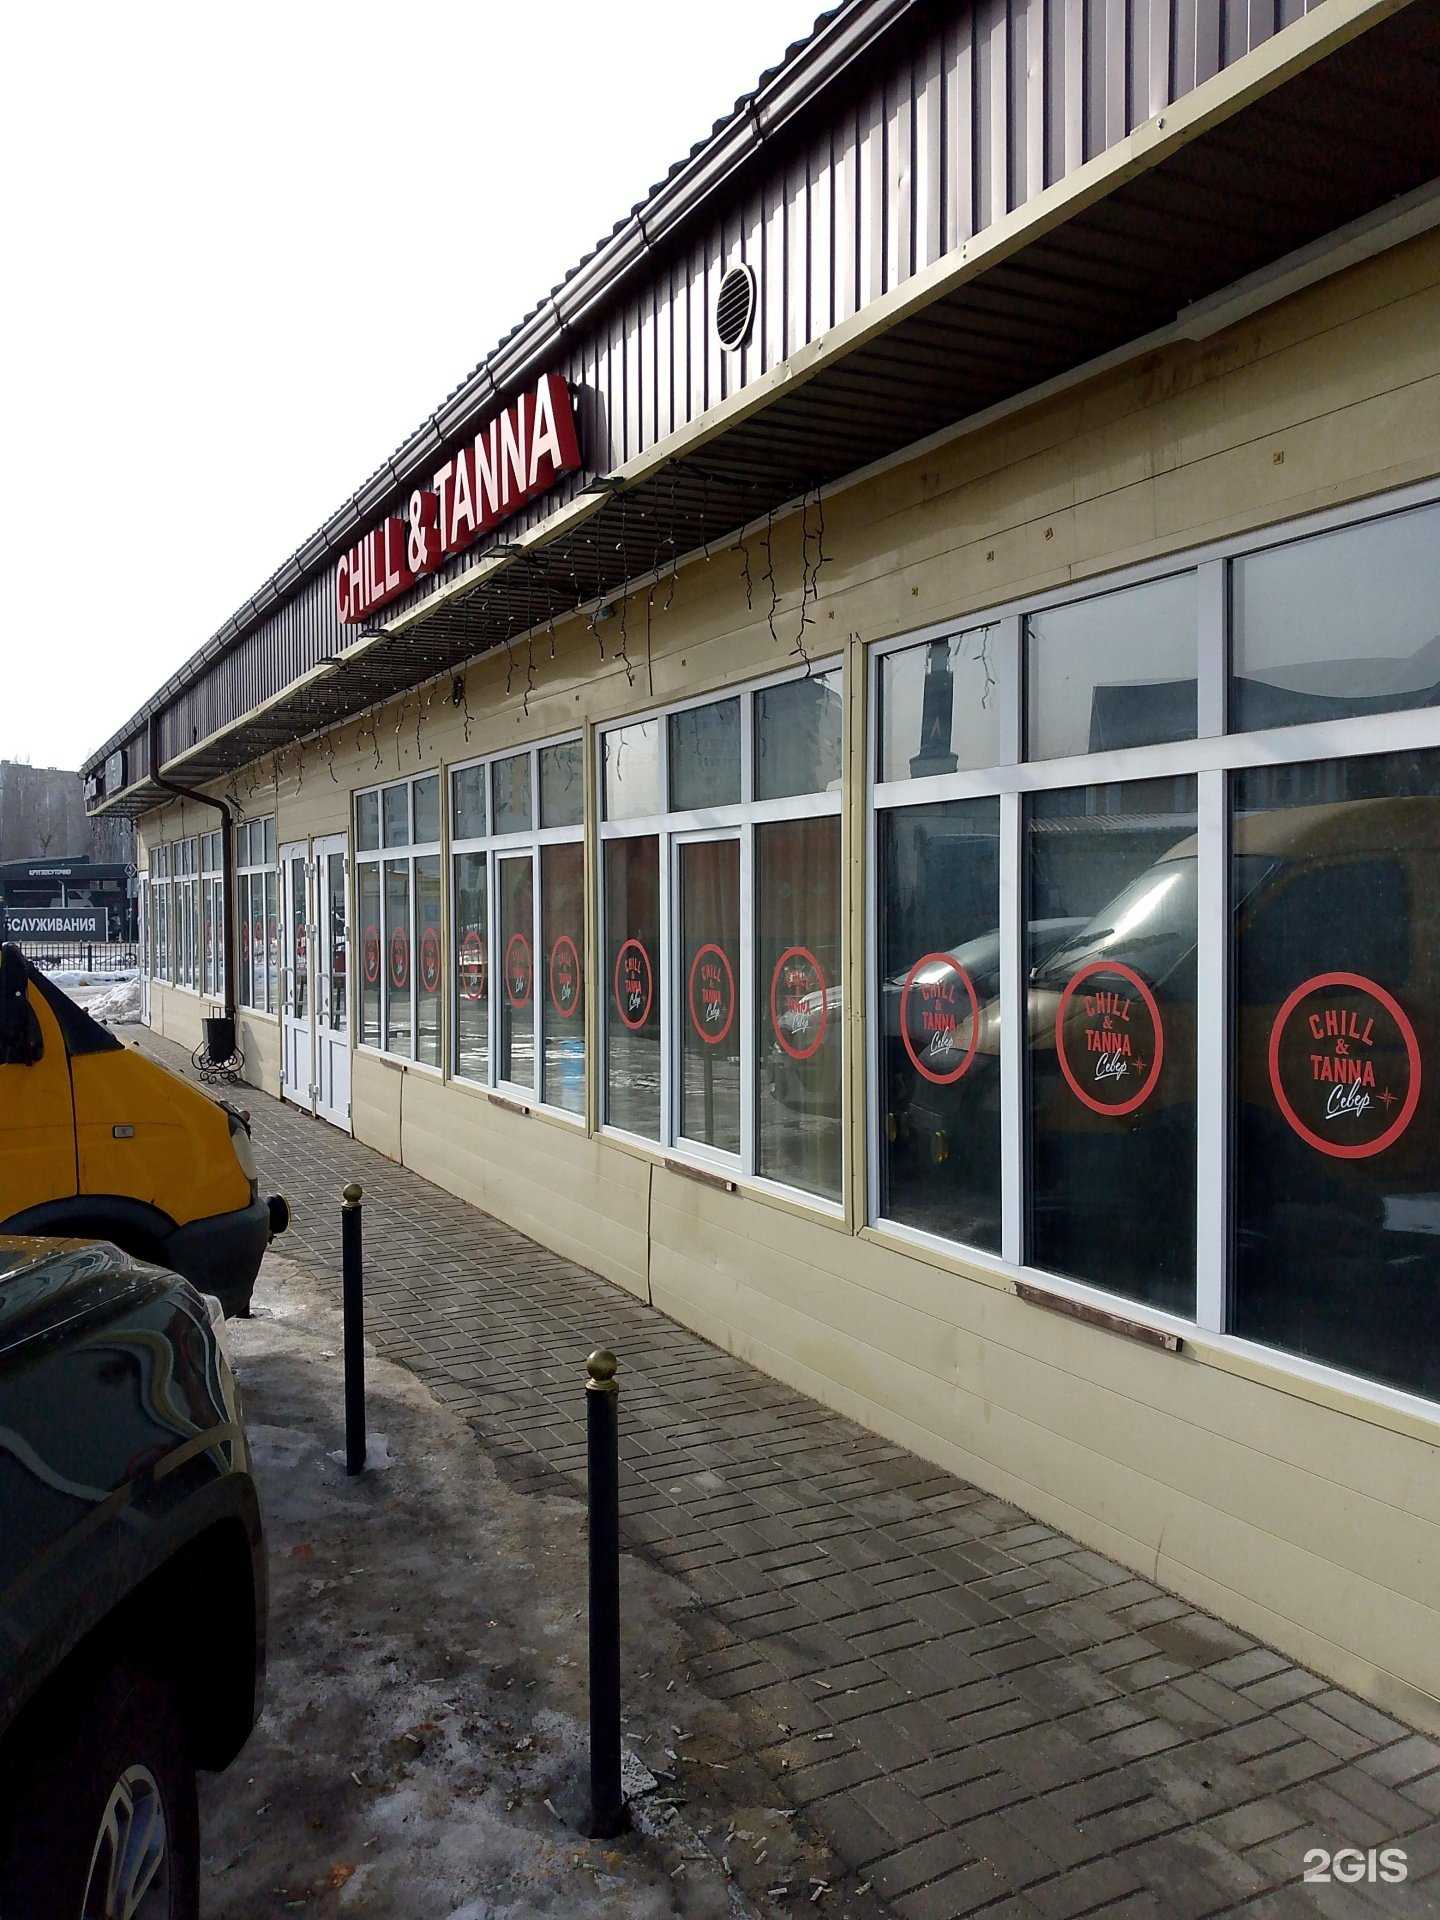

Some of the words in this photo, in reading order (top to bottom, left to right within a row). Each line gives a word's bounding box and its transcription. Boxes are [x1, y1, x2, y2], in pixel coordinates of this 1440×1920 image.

[336, 516, 400, 624] CHILL
[407, 489, 428, 573] &
[433, 372, 563, 552] TANNA
[921, 1011, 957, 1032] TANNA
[1084, 991, 1131, 1022] CHILL
[1102, 1015, 1113, 1030] &
[1308, 1007, 1374, 1046] CHILL
[1085, 1029, 1132, 1057] TANNA
[1335, 1038, 1350, 1055] &
[1310, 1054, 1376, 1088] TANNA
[1325, 1077, 1375, 1120] Север
